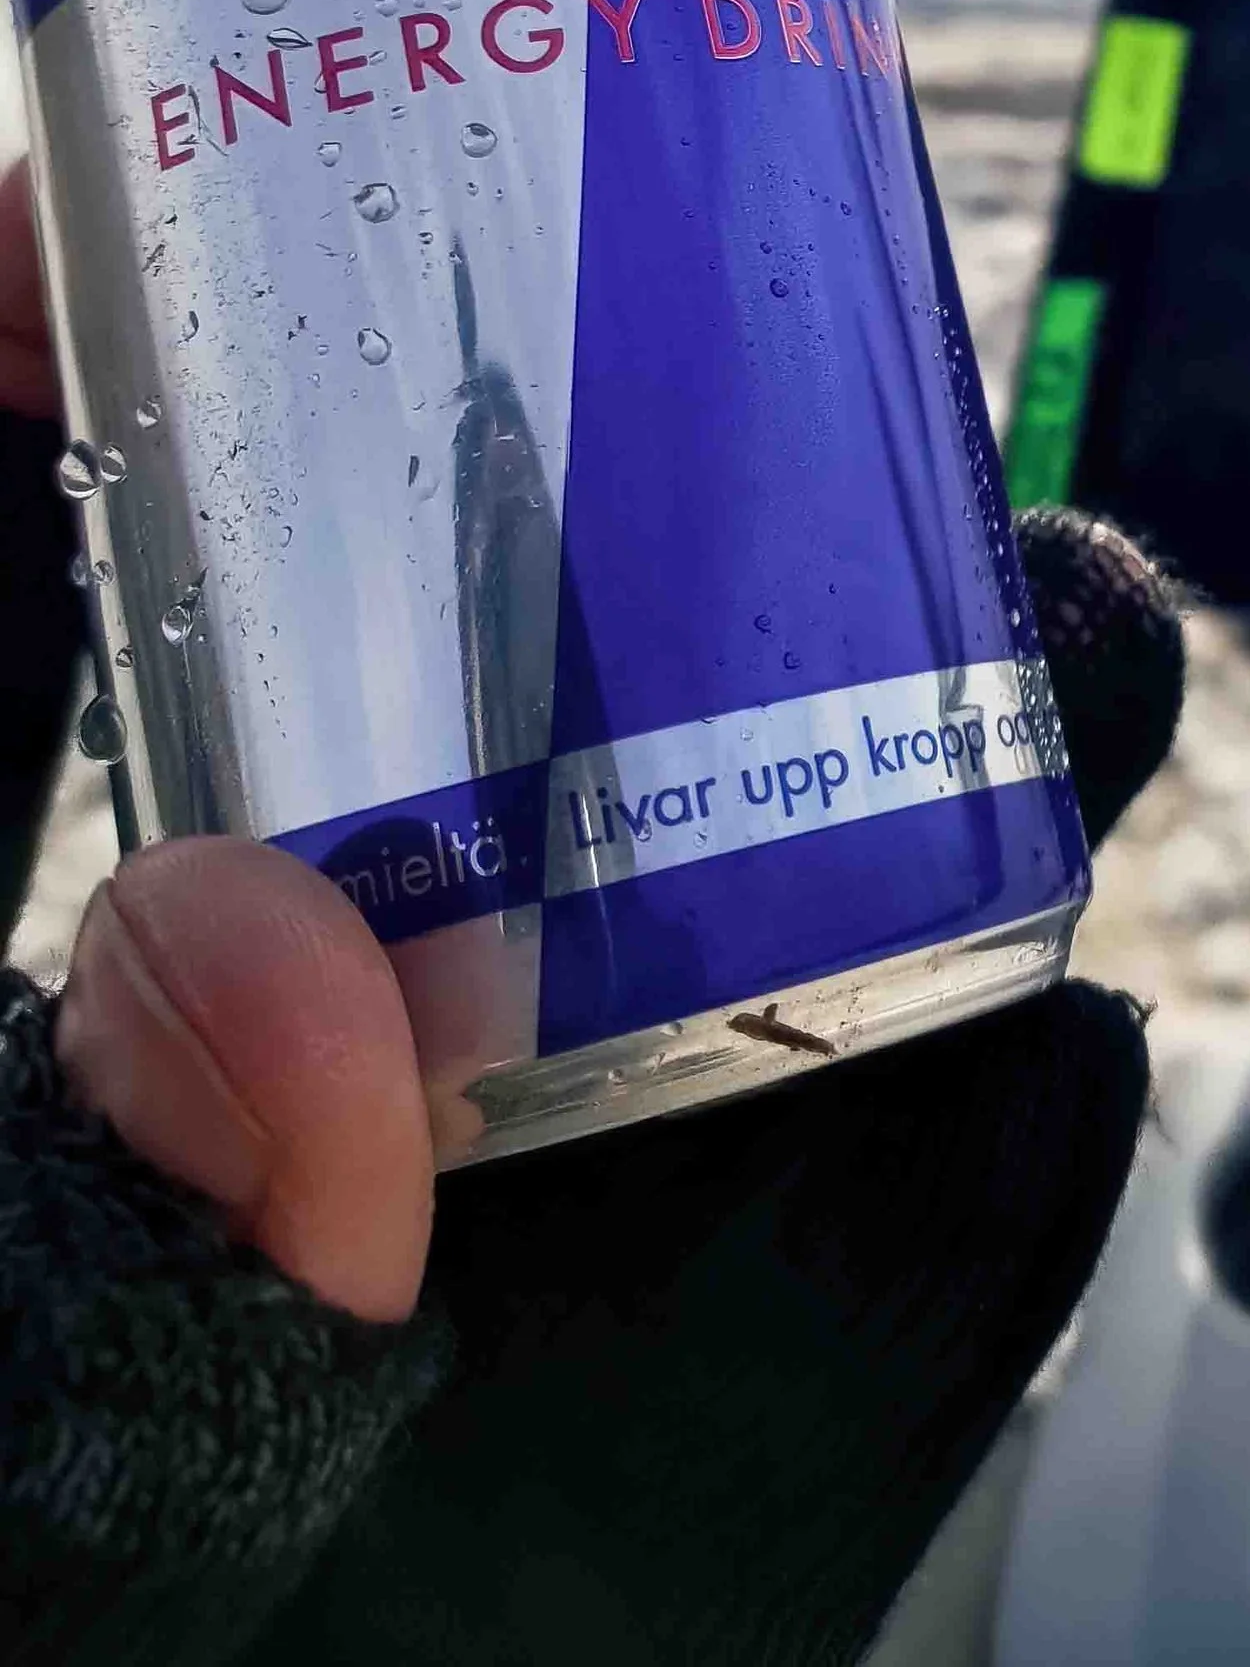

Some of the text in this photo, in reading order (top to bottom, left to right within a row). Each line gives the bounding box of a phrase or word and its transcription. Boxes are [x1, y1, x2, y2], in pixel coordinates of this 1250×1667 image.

[569, 777, 716, 849] Livar
[741, 749, 849, 818] upp
[862, 715, 986, 778] kropp
